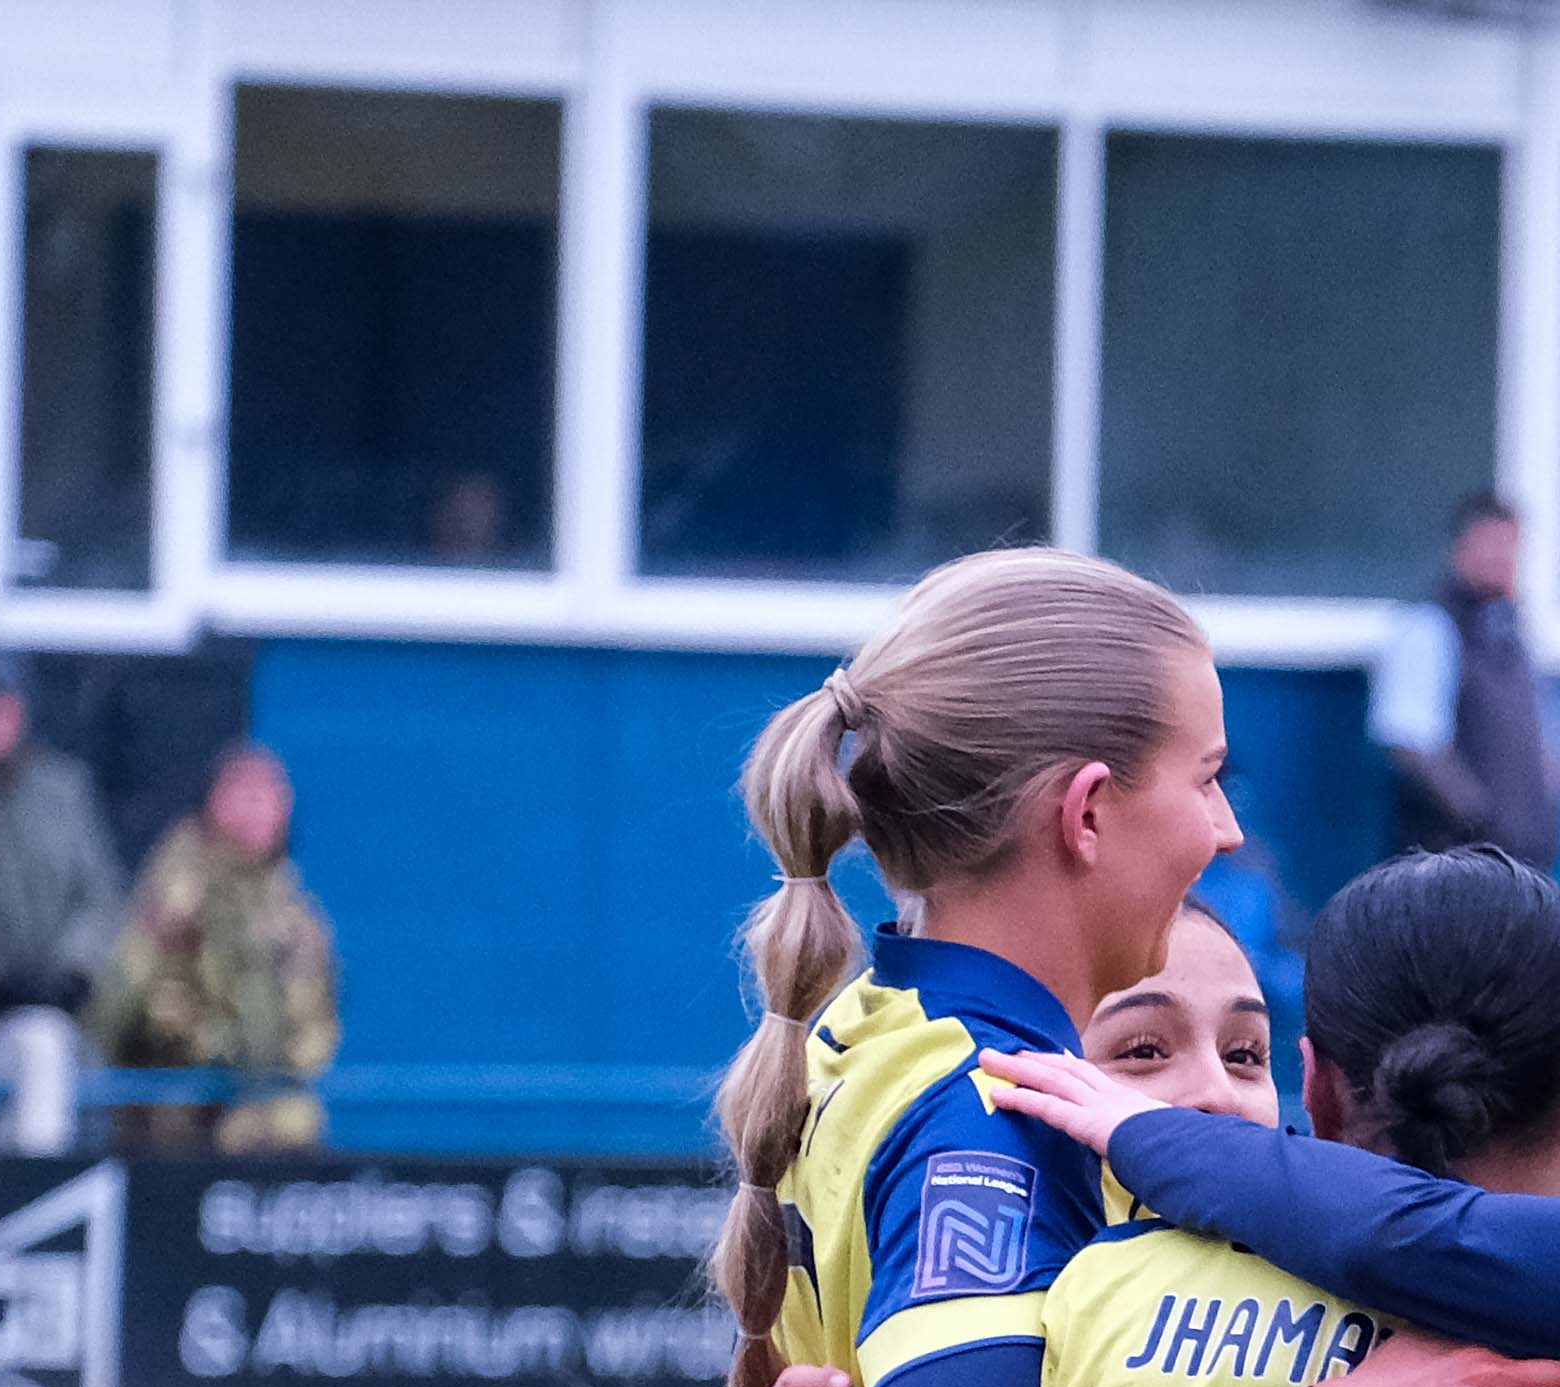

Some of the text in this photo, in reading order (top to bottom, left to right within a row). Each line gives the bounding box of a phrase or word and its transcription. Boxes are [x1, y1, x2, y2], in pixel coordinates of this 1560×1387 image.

[930, 1174, 1028, 1197] National League
[1124, 1293, 1394, 1386] JHAMA
